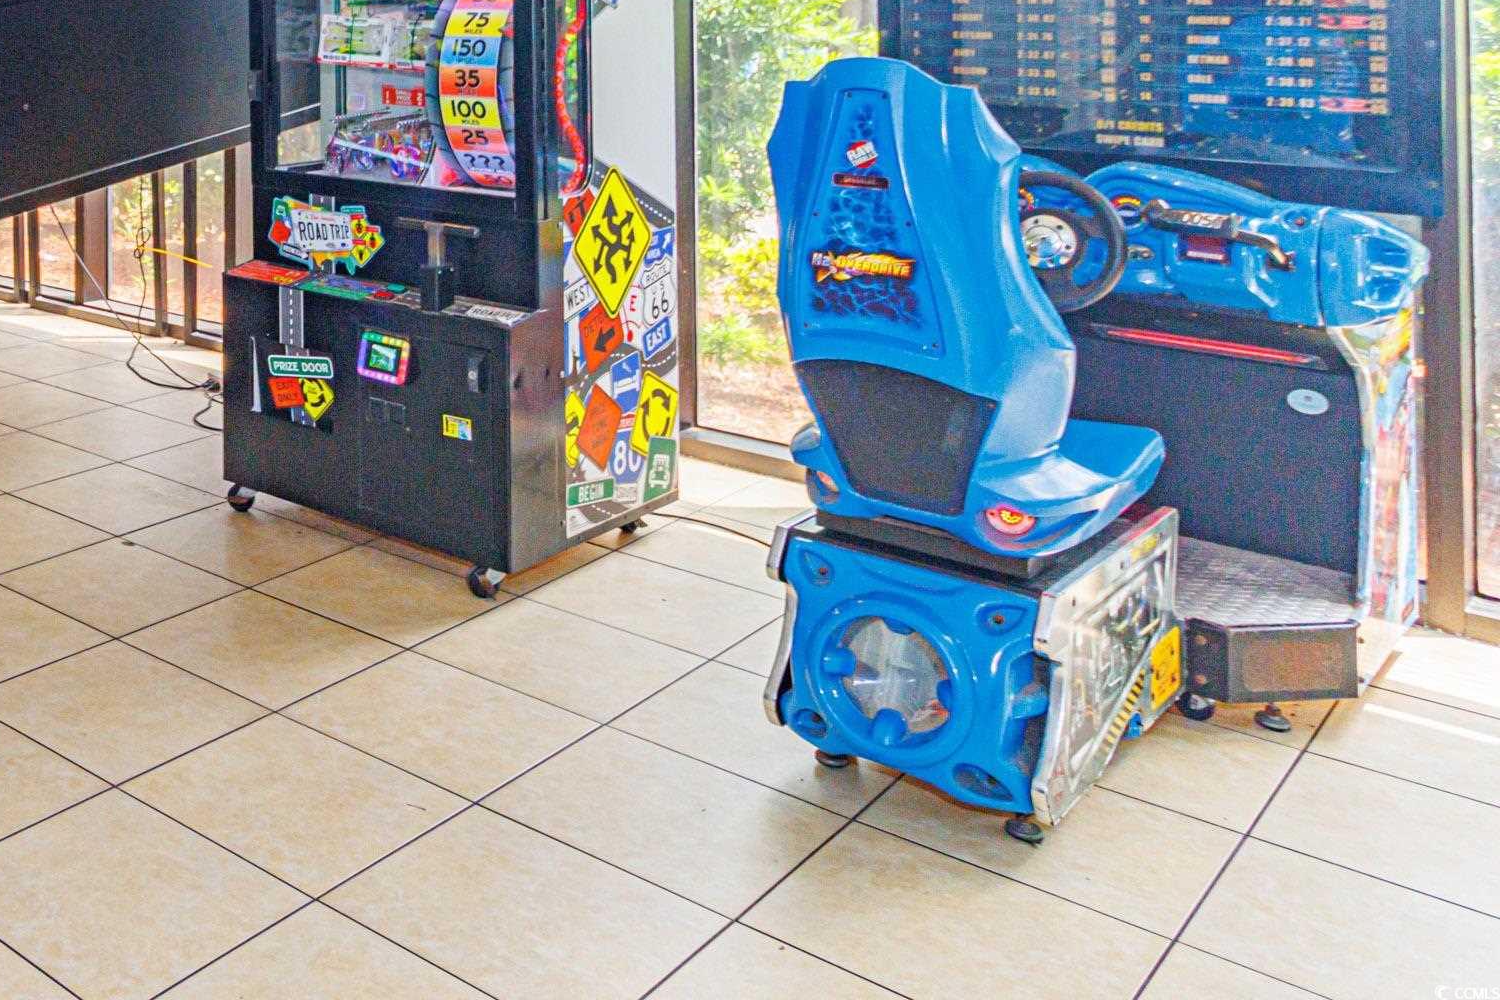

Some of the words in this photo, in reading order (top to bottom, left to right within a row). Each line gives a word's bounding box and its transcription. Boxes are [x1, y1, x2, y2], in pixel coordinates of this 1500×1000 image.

[464, 12, 490, 28] 75
[452, 39, 486, 57] 150
[455, 69, 480, 88] 35
[451, 100, 486, 118] 100
[463, 129, 488, 145] 25
[298, 221, 328, 241] ROAD
[329, 223, 349, 240] TRIP
[645, 265, 667, 281] ROUTE
[838, 253, 913, 276] OVERDRIVE
[566, 282, 590, 309] WEST
[651, 291, 670, 319] 66
[647, 322, 668, 347] EAST
[273, 361, 299, 372] PRIZE
[301, 362, 329, 373] DOOR
[613, 439, 642, 475] 80
[578, 482, 605, 503] BEGIN
